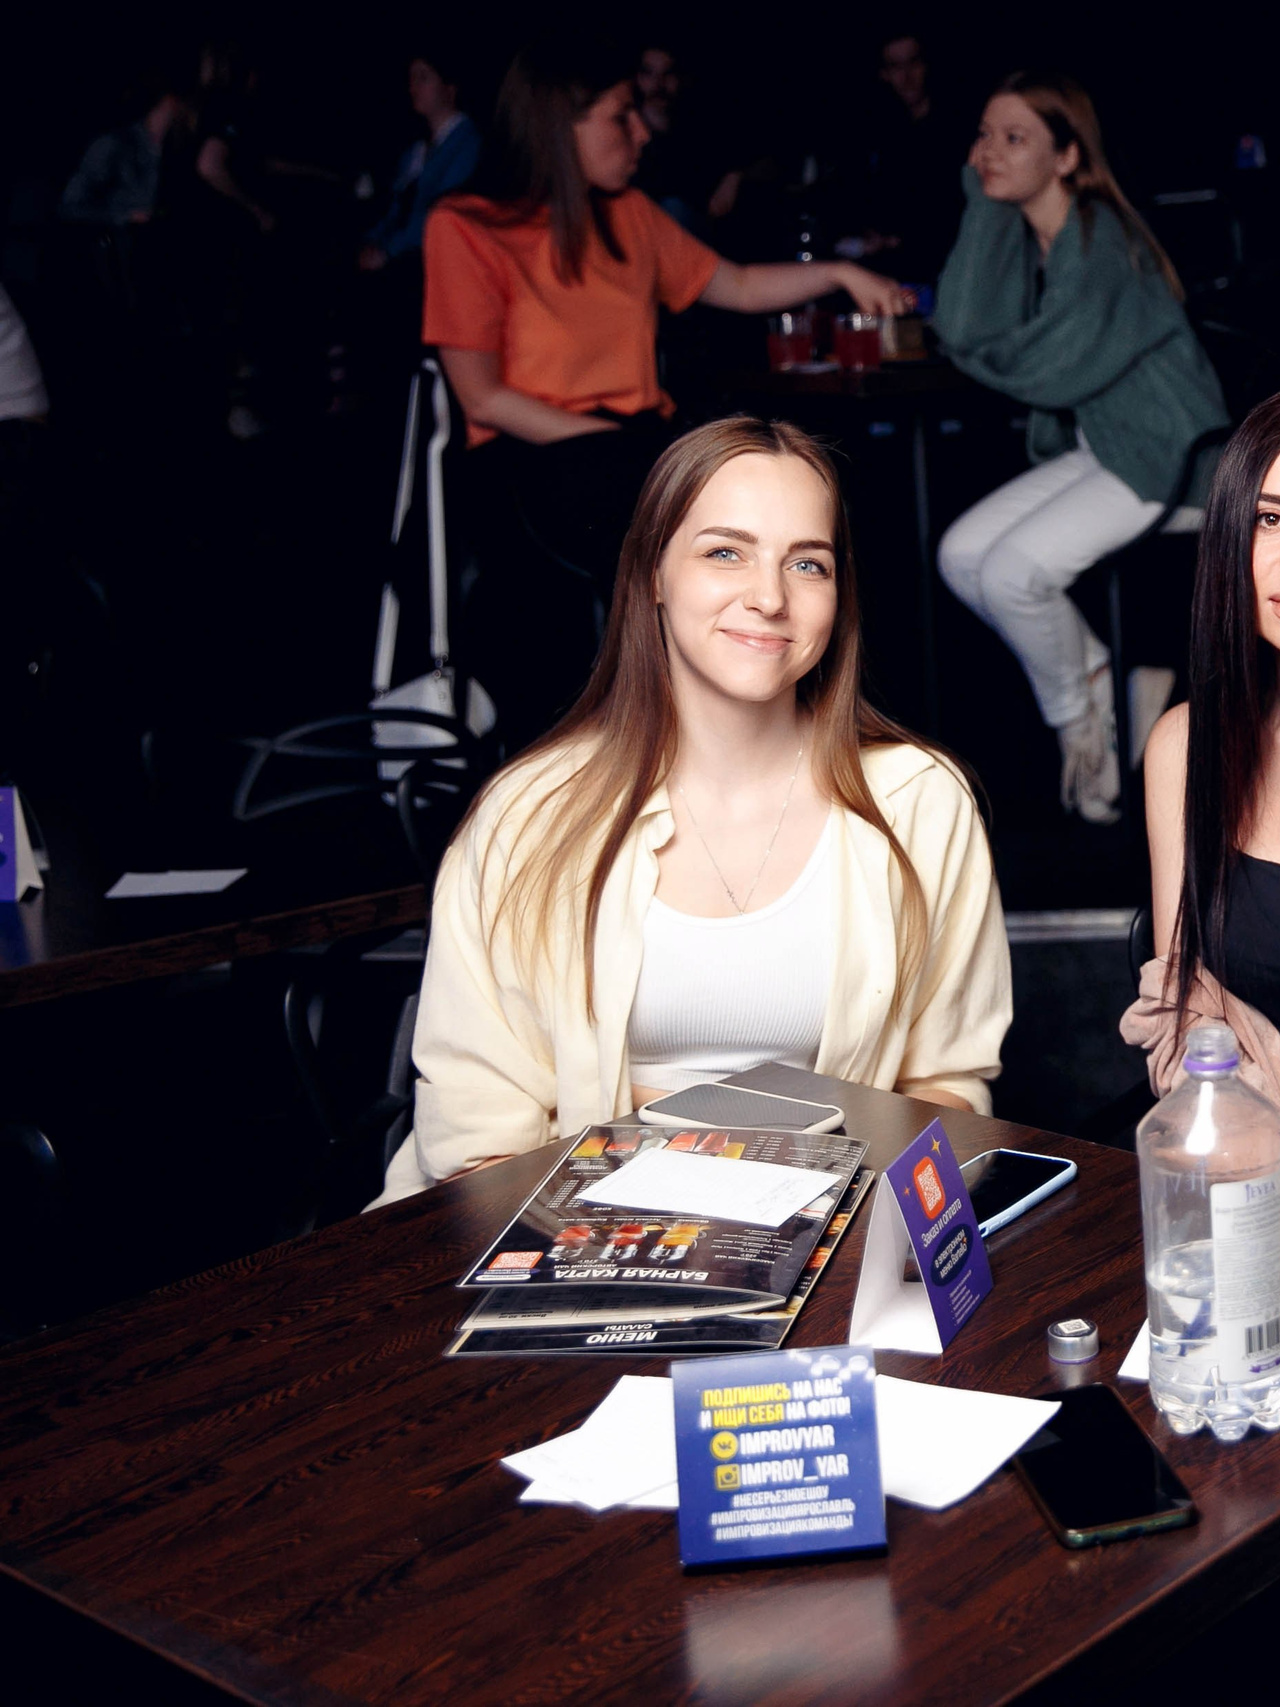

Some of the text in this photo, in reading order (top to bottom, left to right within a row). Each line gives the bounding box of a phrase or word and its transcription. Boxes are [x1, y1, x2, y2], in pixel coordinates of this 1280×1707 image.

[922, 1224, 938, 1247] Заказ
[942, 1198, 961, 1224] оплата
[555, 1269, 709, 1281] БАРНАЯ КАРТА
[586, 1331, 658, 1344] МЕНЮ
[604, 1323, 653, 1331] САЛАТЫ
[703, 1377, 844, 1407] ПОДПИШИСЬ НА НАС
[700, 1396, 851, 1429] И ИЩИ СЕБЯ НА ФОТО!
[740, 1424, 835, 1455] IMPROVYAR
[741, 1454, 849, 1485] IMPROV_YAR
[733, 1485, 829, 1508] #НЕСЕРЬЕЗНОЕШОУ
[715, 1514, 854, 1541] #ИМПРОВИЗАЦИЯКОМАНДЫ
